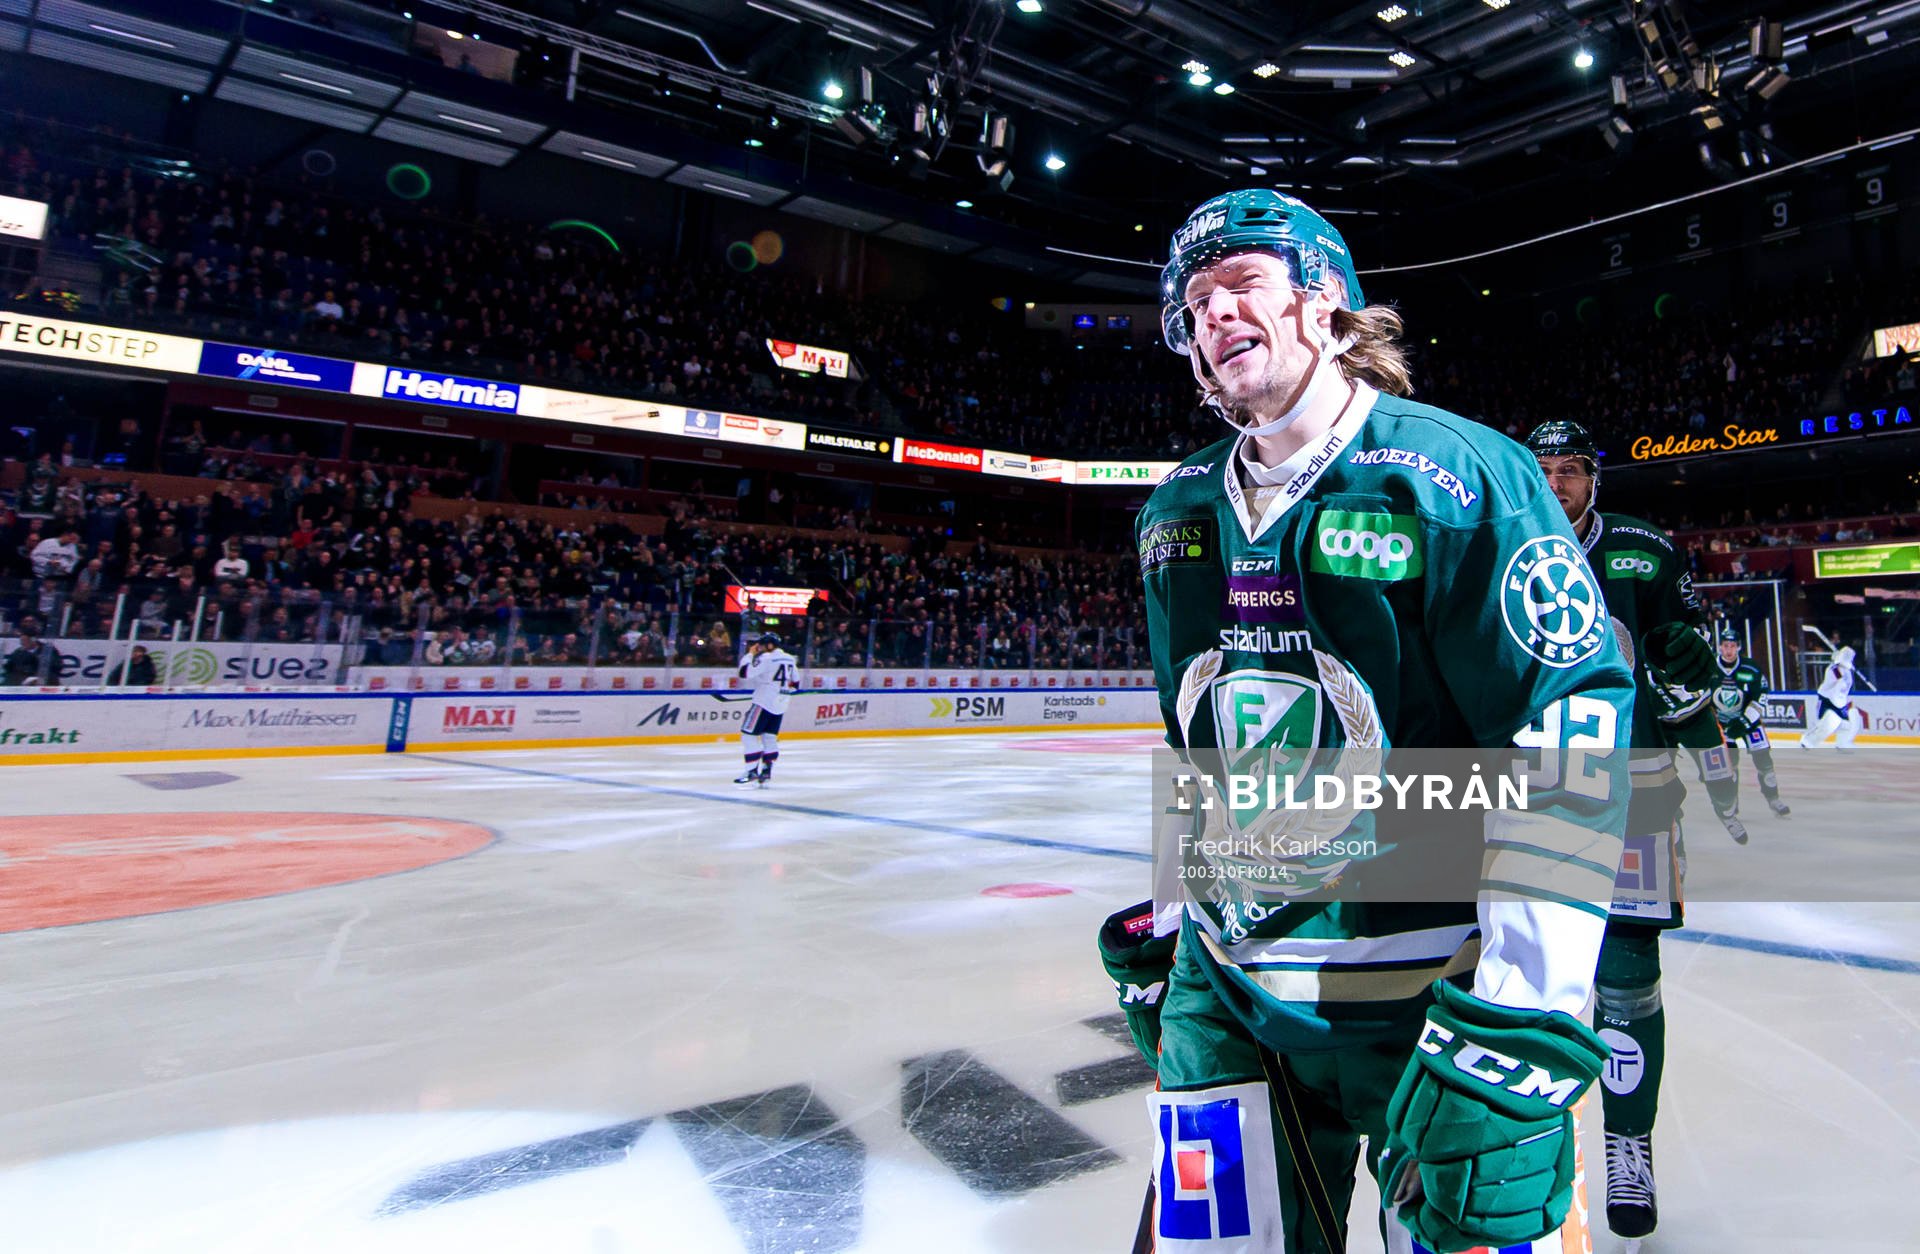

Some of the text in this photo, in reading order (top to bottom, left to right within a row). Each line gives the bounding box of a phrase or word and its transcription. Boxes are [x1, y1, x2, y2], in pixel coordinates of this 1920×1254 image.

[1867, 178, 1883, 204] 9
[1773, 202, 1788, 228] 9
[1687, 223, 1700, 248] 5
[385, 369, 517, 409] Helmia
[1800, 406, 1912, 436] RESTA
[809, 433, 877, 452] KARLSTAD.SE
[1631, 424, 1779, 460] Golden Star
[906, 446, 980, 466] McDonald's
[1286, 434, 1343, 499] stadium
[1090, 467, 1150, 479] PEAB
[1350, 448, 1477, 508] MOELVEN
[1146, 542, 1189, 565] HUSET
[1319, 528, 1414, 569] coop
[1232, 559, 1274, 572] CCM
[1219, 624, 1313, 654] stadium
[955, 696, 1005, 718] PSM
[1043, 695, 1096, 707] Karlstads
[182, 707, 358, 729] Max Matthiessen
[443, 706, 516, 728] MAXI
[1043, 708, 1078, 722] Energi
[1603, 1015, 1631, 1027] CCM
[1416, 1017, 1584, 1108] CCM
